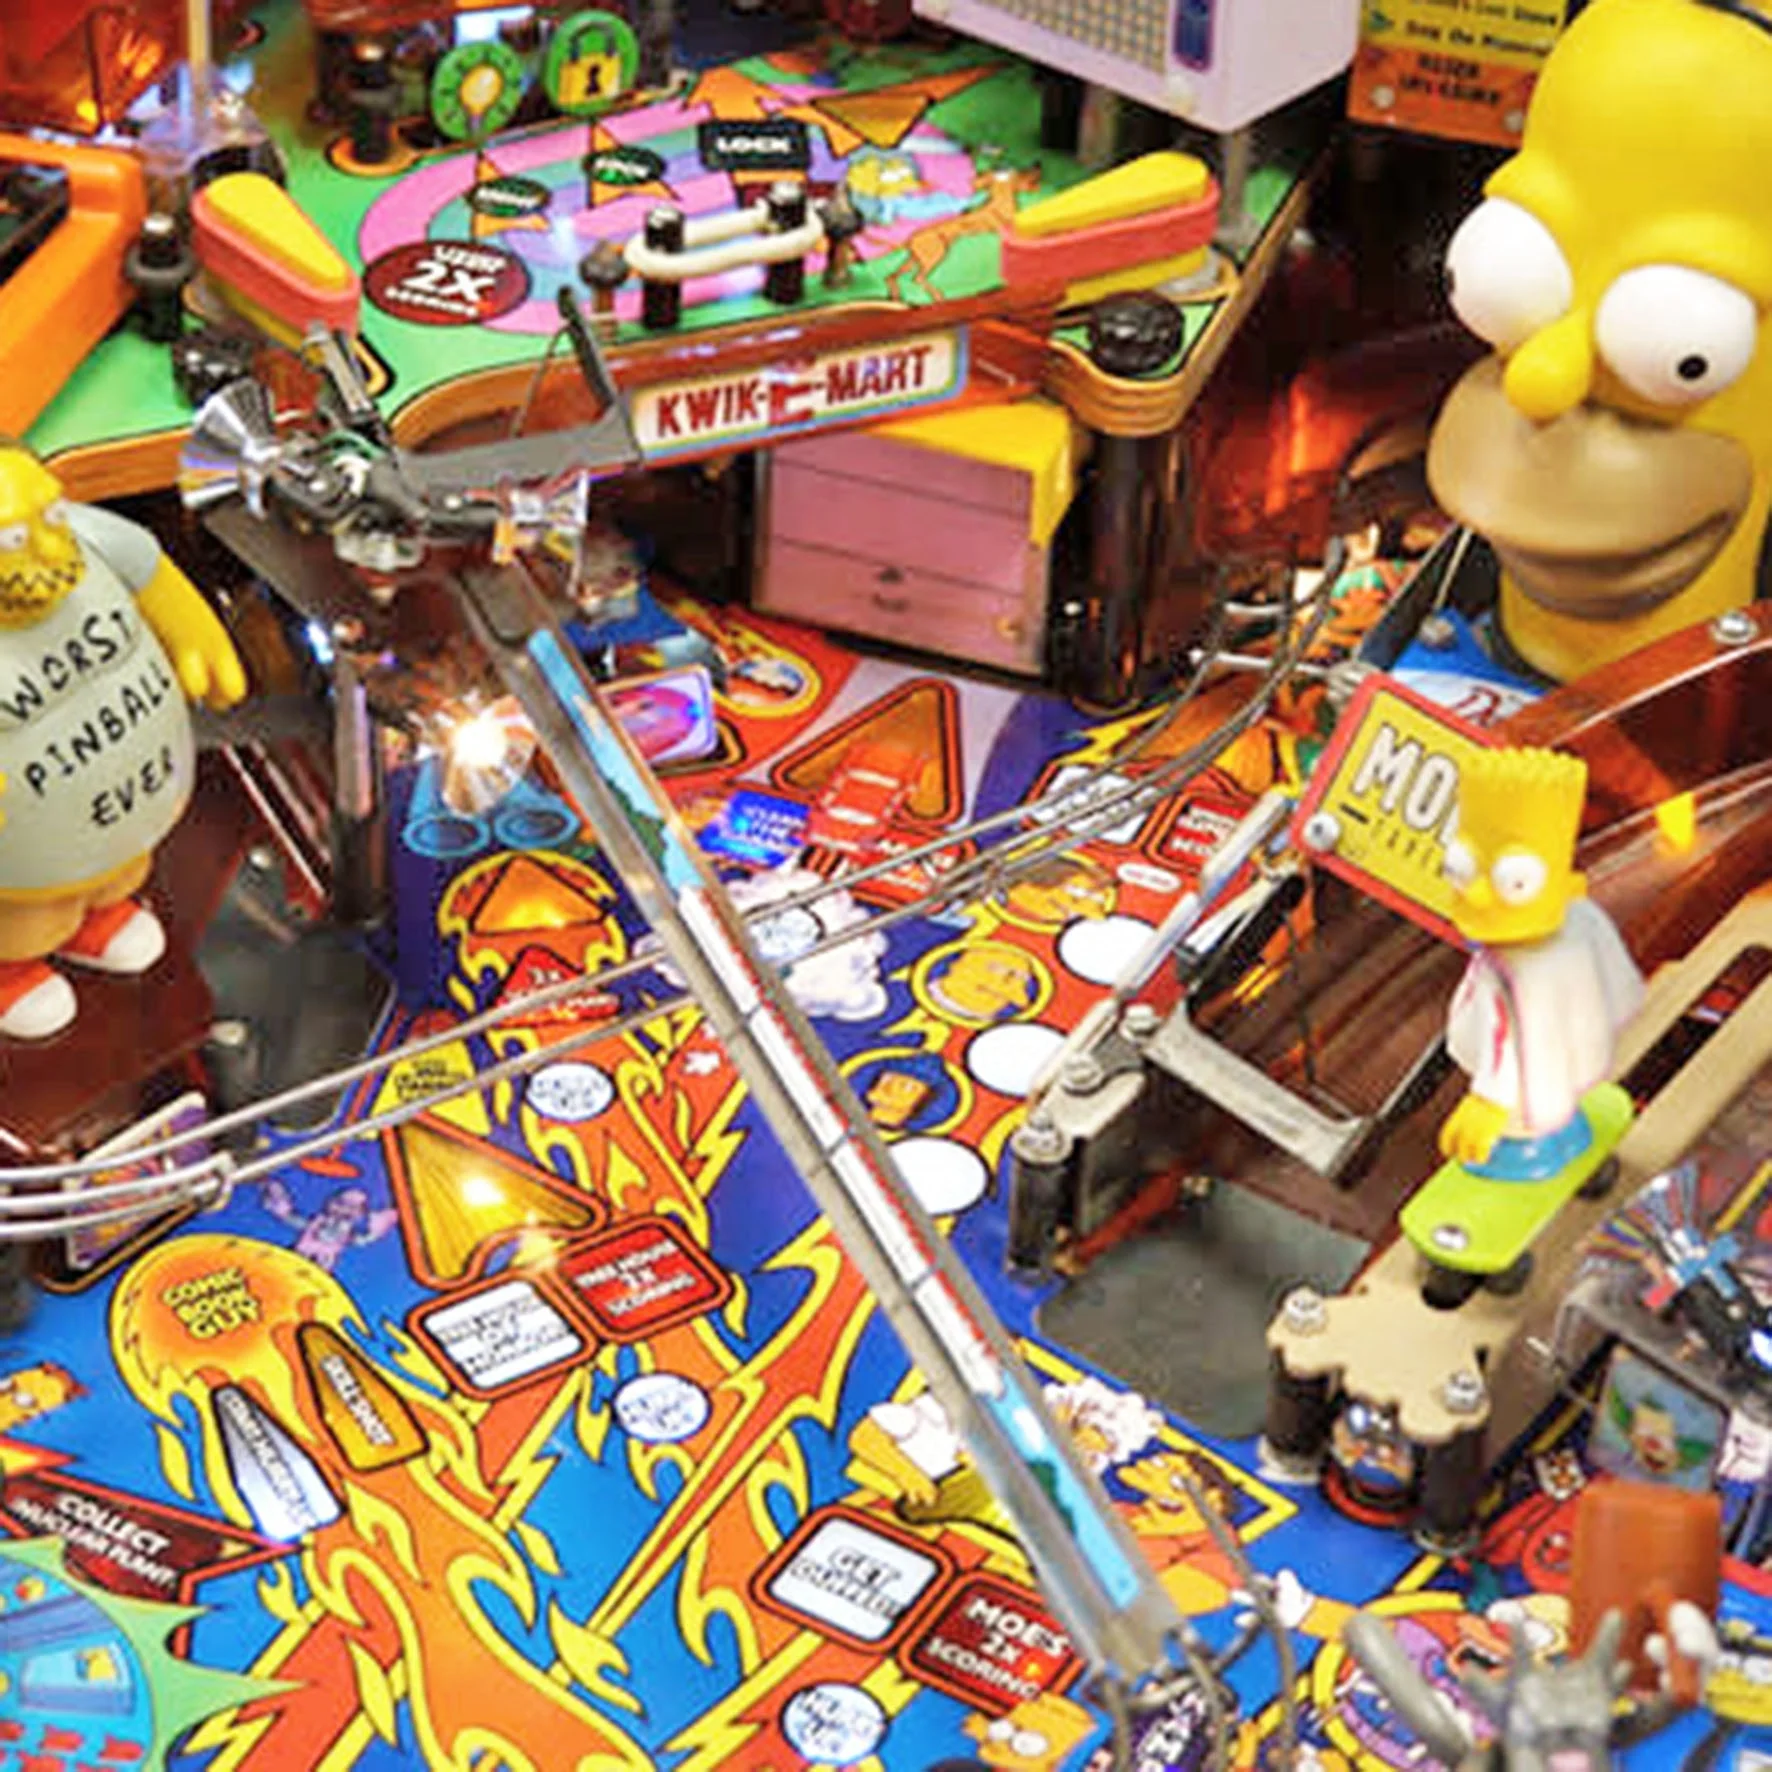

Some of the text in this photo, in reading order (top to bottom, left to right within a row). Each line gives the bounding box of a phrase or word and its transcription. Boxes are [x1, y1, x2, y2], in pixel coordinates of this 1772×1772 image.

[402, 259, 496, 302] 2X
[1351, 721, 1460, 844] MO
[57, 1492, 172, 1556] COLLECT
